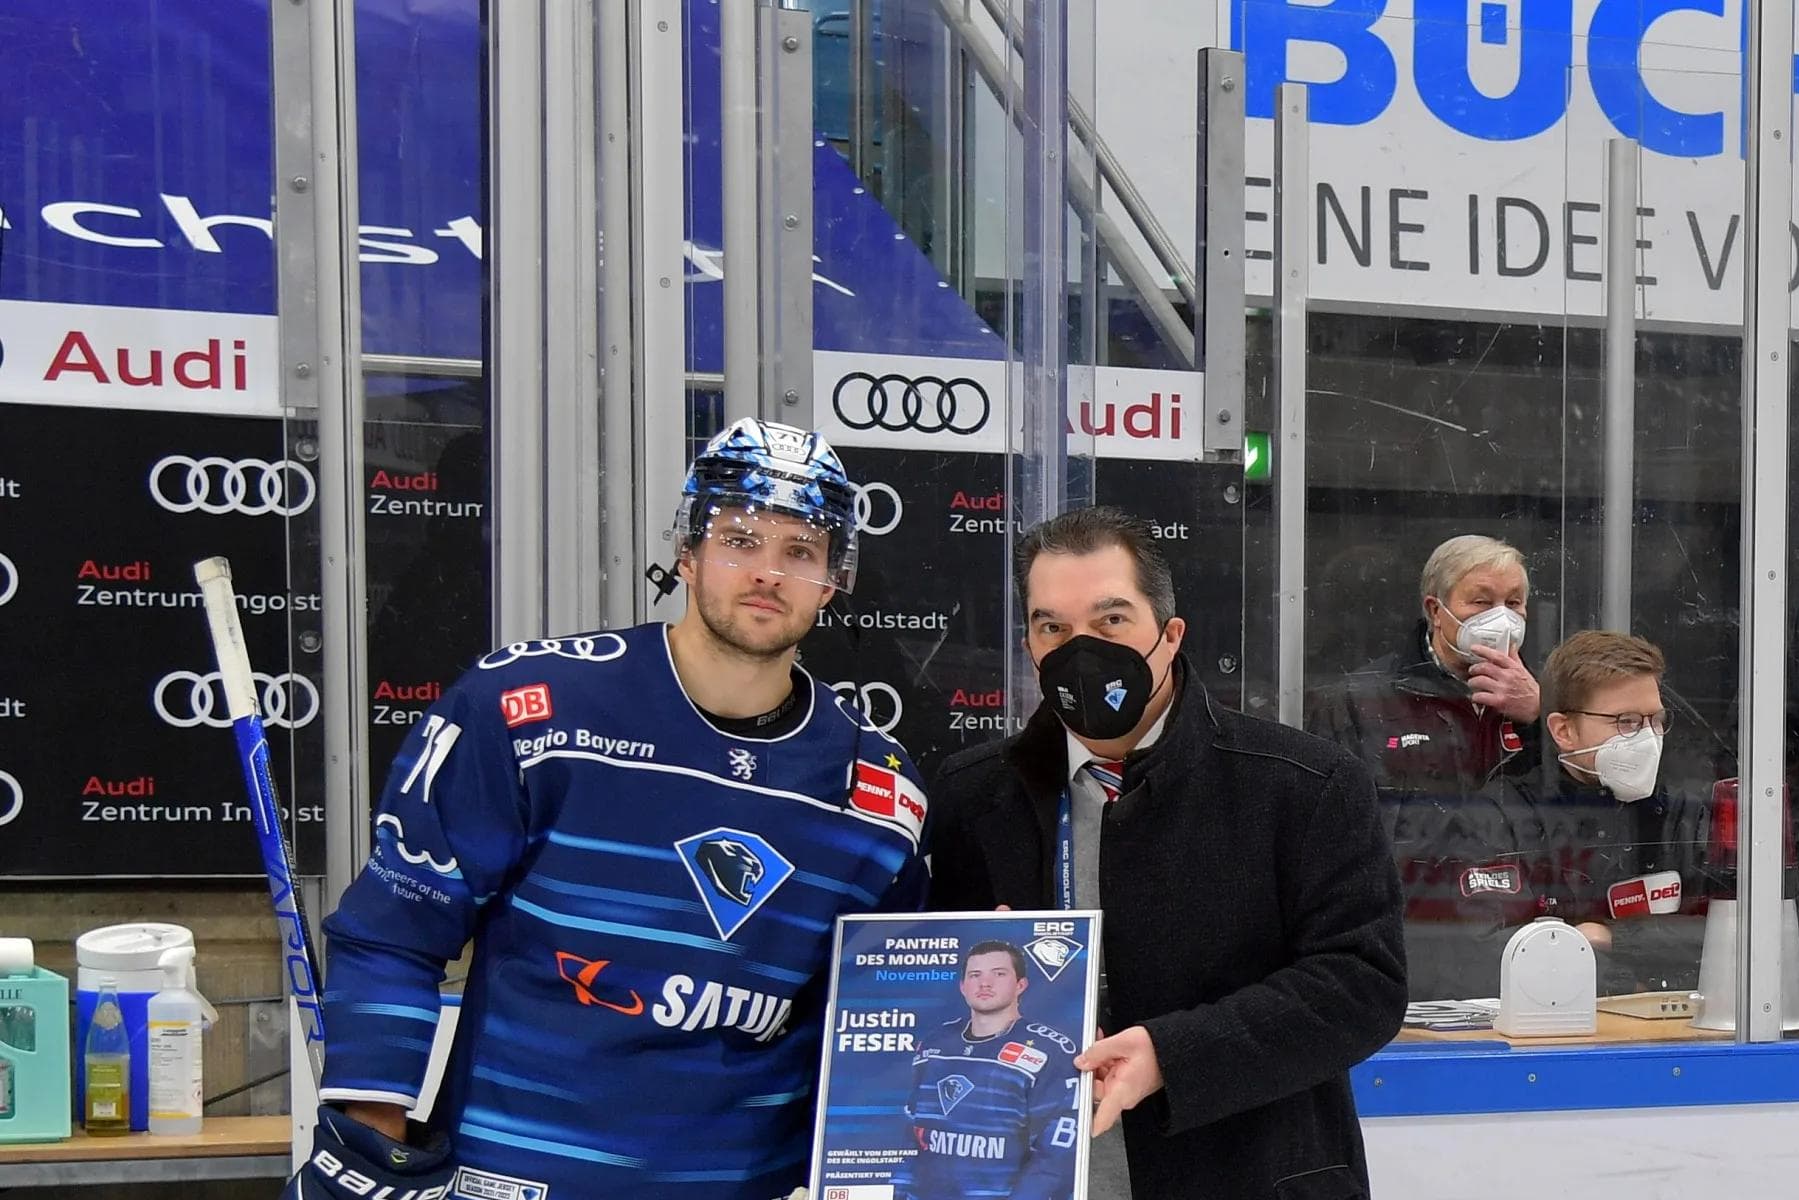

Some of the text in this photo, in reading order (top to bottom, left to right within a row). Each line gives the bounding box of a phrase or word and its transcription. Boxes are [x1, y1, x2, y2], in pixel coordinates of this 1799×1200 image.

[1245, 177, 1431, 272] ENE
[43, 331, 247, 390] Audi
[371, 470, 438, 490] Audi
[78, 559, 150, 581] Audi
[374, 681, 440, 700] Audi
[504, 691, 544, 721] DB
[575, 729, 655, 760] Bayern
[82, 776, 155, 796] Audi
[81, 801, 213, 822] Zentrum
[1063, 862, 1071, 911] INGOLSTA
[1034, 922, 1075, 933] ERC
[886, 938, 959, 950] PANTHER
[856, 953, 958, 965] DES MONATS
[875, 969, 956, 981] November
[837, 1009, 916, 1032] Justin
[838, 1033, 914, 1052] FESER
[929, 1130, 1005, 1159] SATURN
